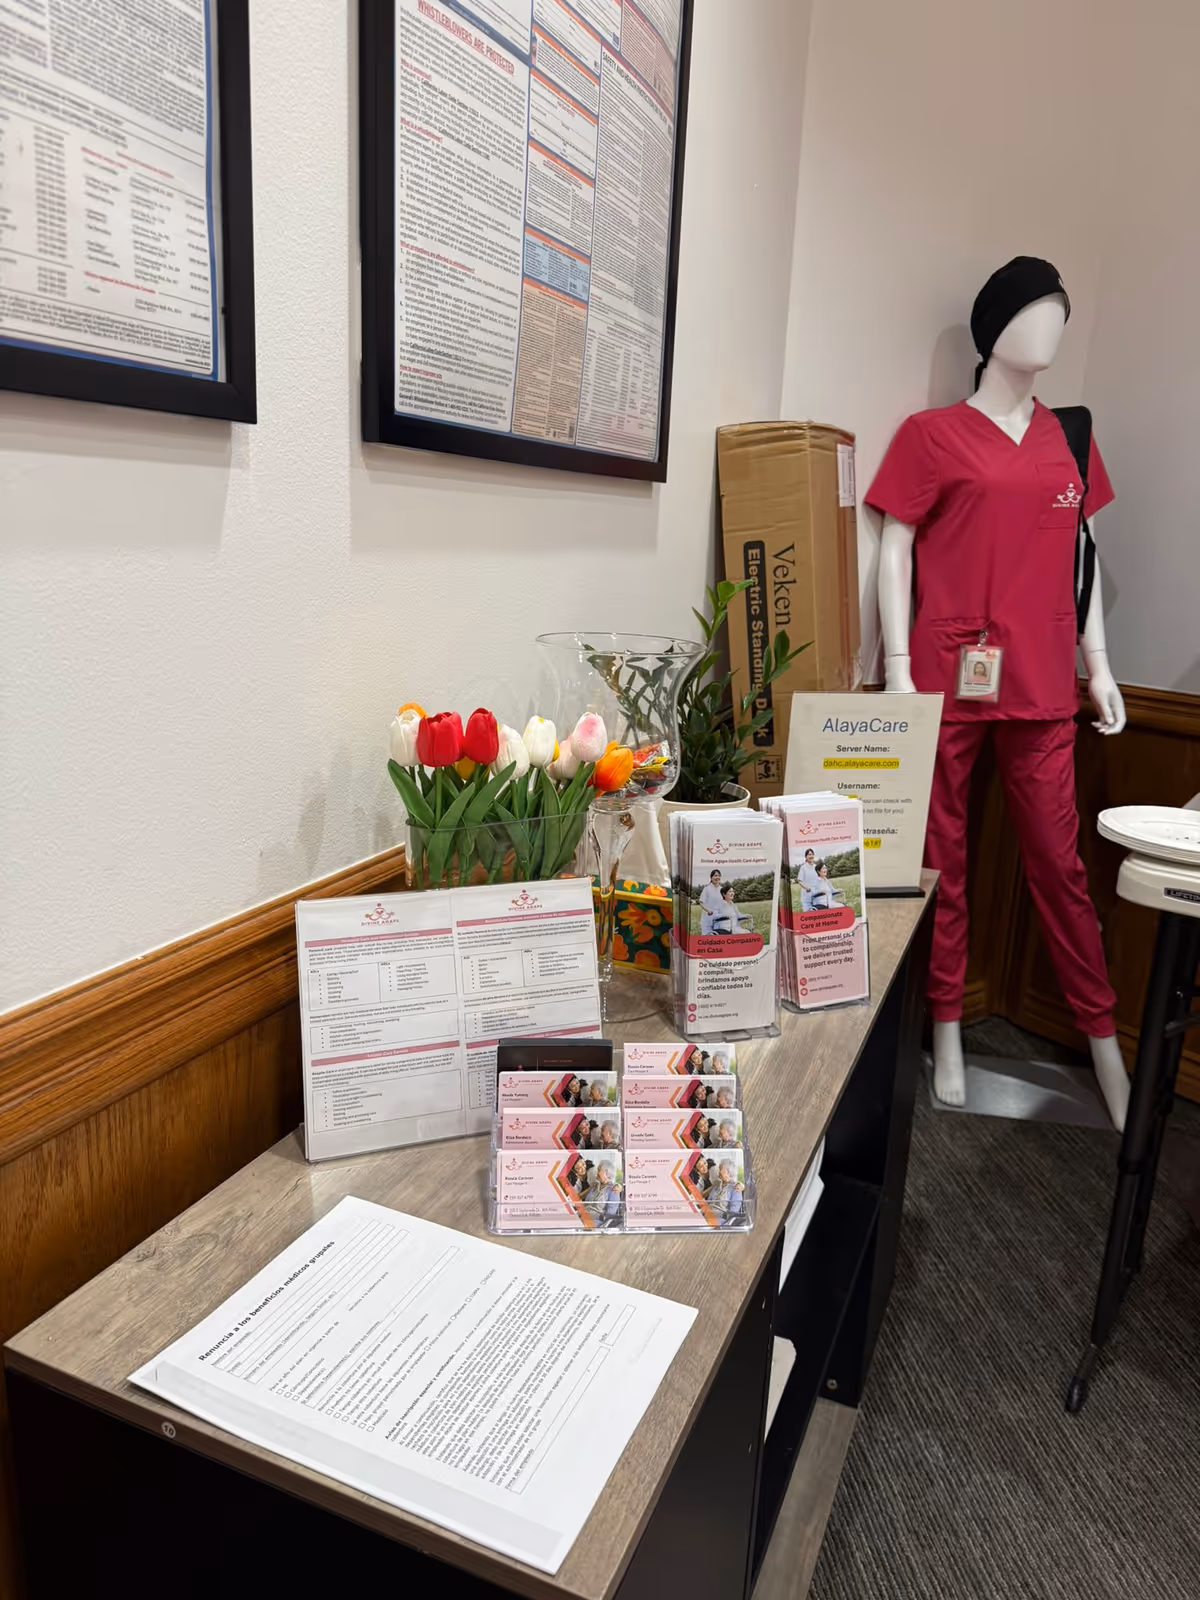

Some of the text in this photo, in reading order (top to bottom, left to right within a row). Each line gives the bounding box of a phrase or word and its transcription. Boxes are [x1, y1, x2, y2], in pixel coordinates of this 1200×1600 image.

[474, 37, 486, 56] ARE
[486, 43, 515, 75] PROTECTED
[771, 542, 797, 628] Veken
[747, 548, 769, 738] Electric Standing Dk
[823, 718, 908, 735] AlayaCare
[823, 759, 899, 768] dahc.alayacare.com
[800, 911, 843, 922] Compassionate
[727, 937, 761, 945] Compasivo
[810, 940, 854, 953] companionship,
[818, 933, 841, 943] personal
[812, 951, 832, 960] deliver
[833, 948, 853, 957] trusted
[804, 960, 826, 969] support
[827, 958, 842, 966] every
[197, 1331, 234, 1361] Renuncia
[236, 1316, 252, 1326] los
[248, 1286, 286, 1316] beneficios
[281, 1263, 311, 1286] médicos
[307, 1240, 338, 1264] grupales
[346, 1403, 361, 1416] Tengo
[364, 1377, 383, 1395] cobertura
[371, 1408, 389, 1426] Medicaid
[383, 1426, 397, 1439] Aviso
[399, 1396, 421, 1420] inscripción
[418, 1380, 435, 1397] especial
[164, 1425, 174, 1436] 10
[503, 1442, 526, 1472] administrador
[504, 1476, 516, 1490] Firma
[518, 1448, 535, 1469] empleado
